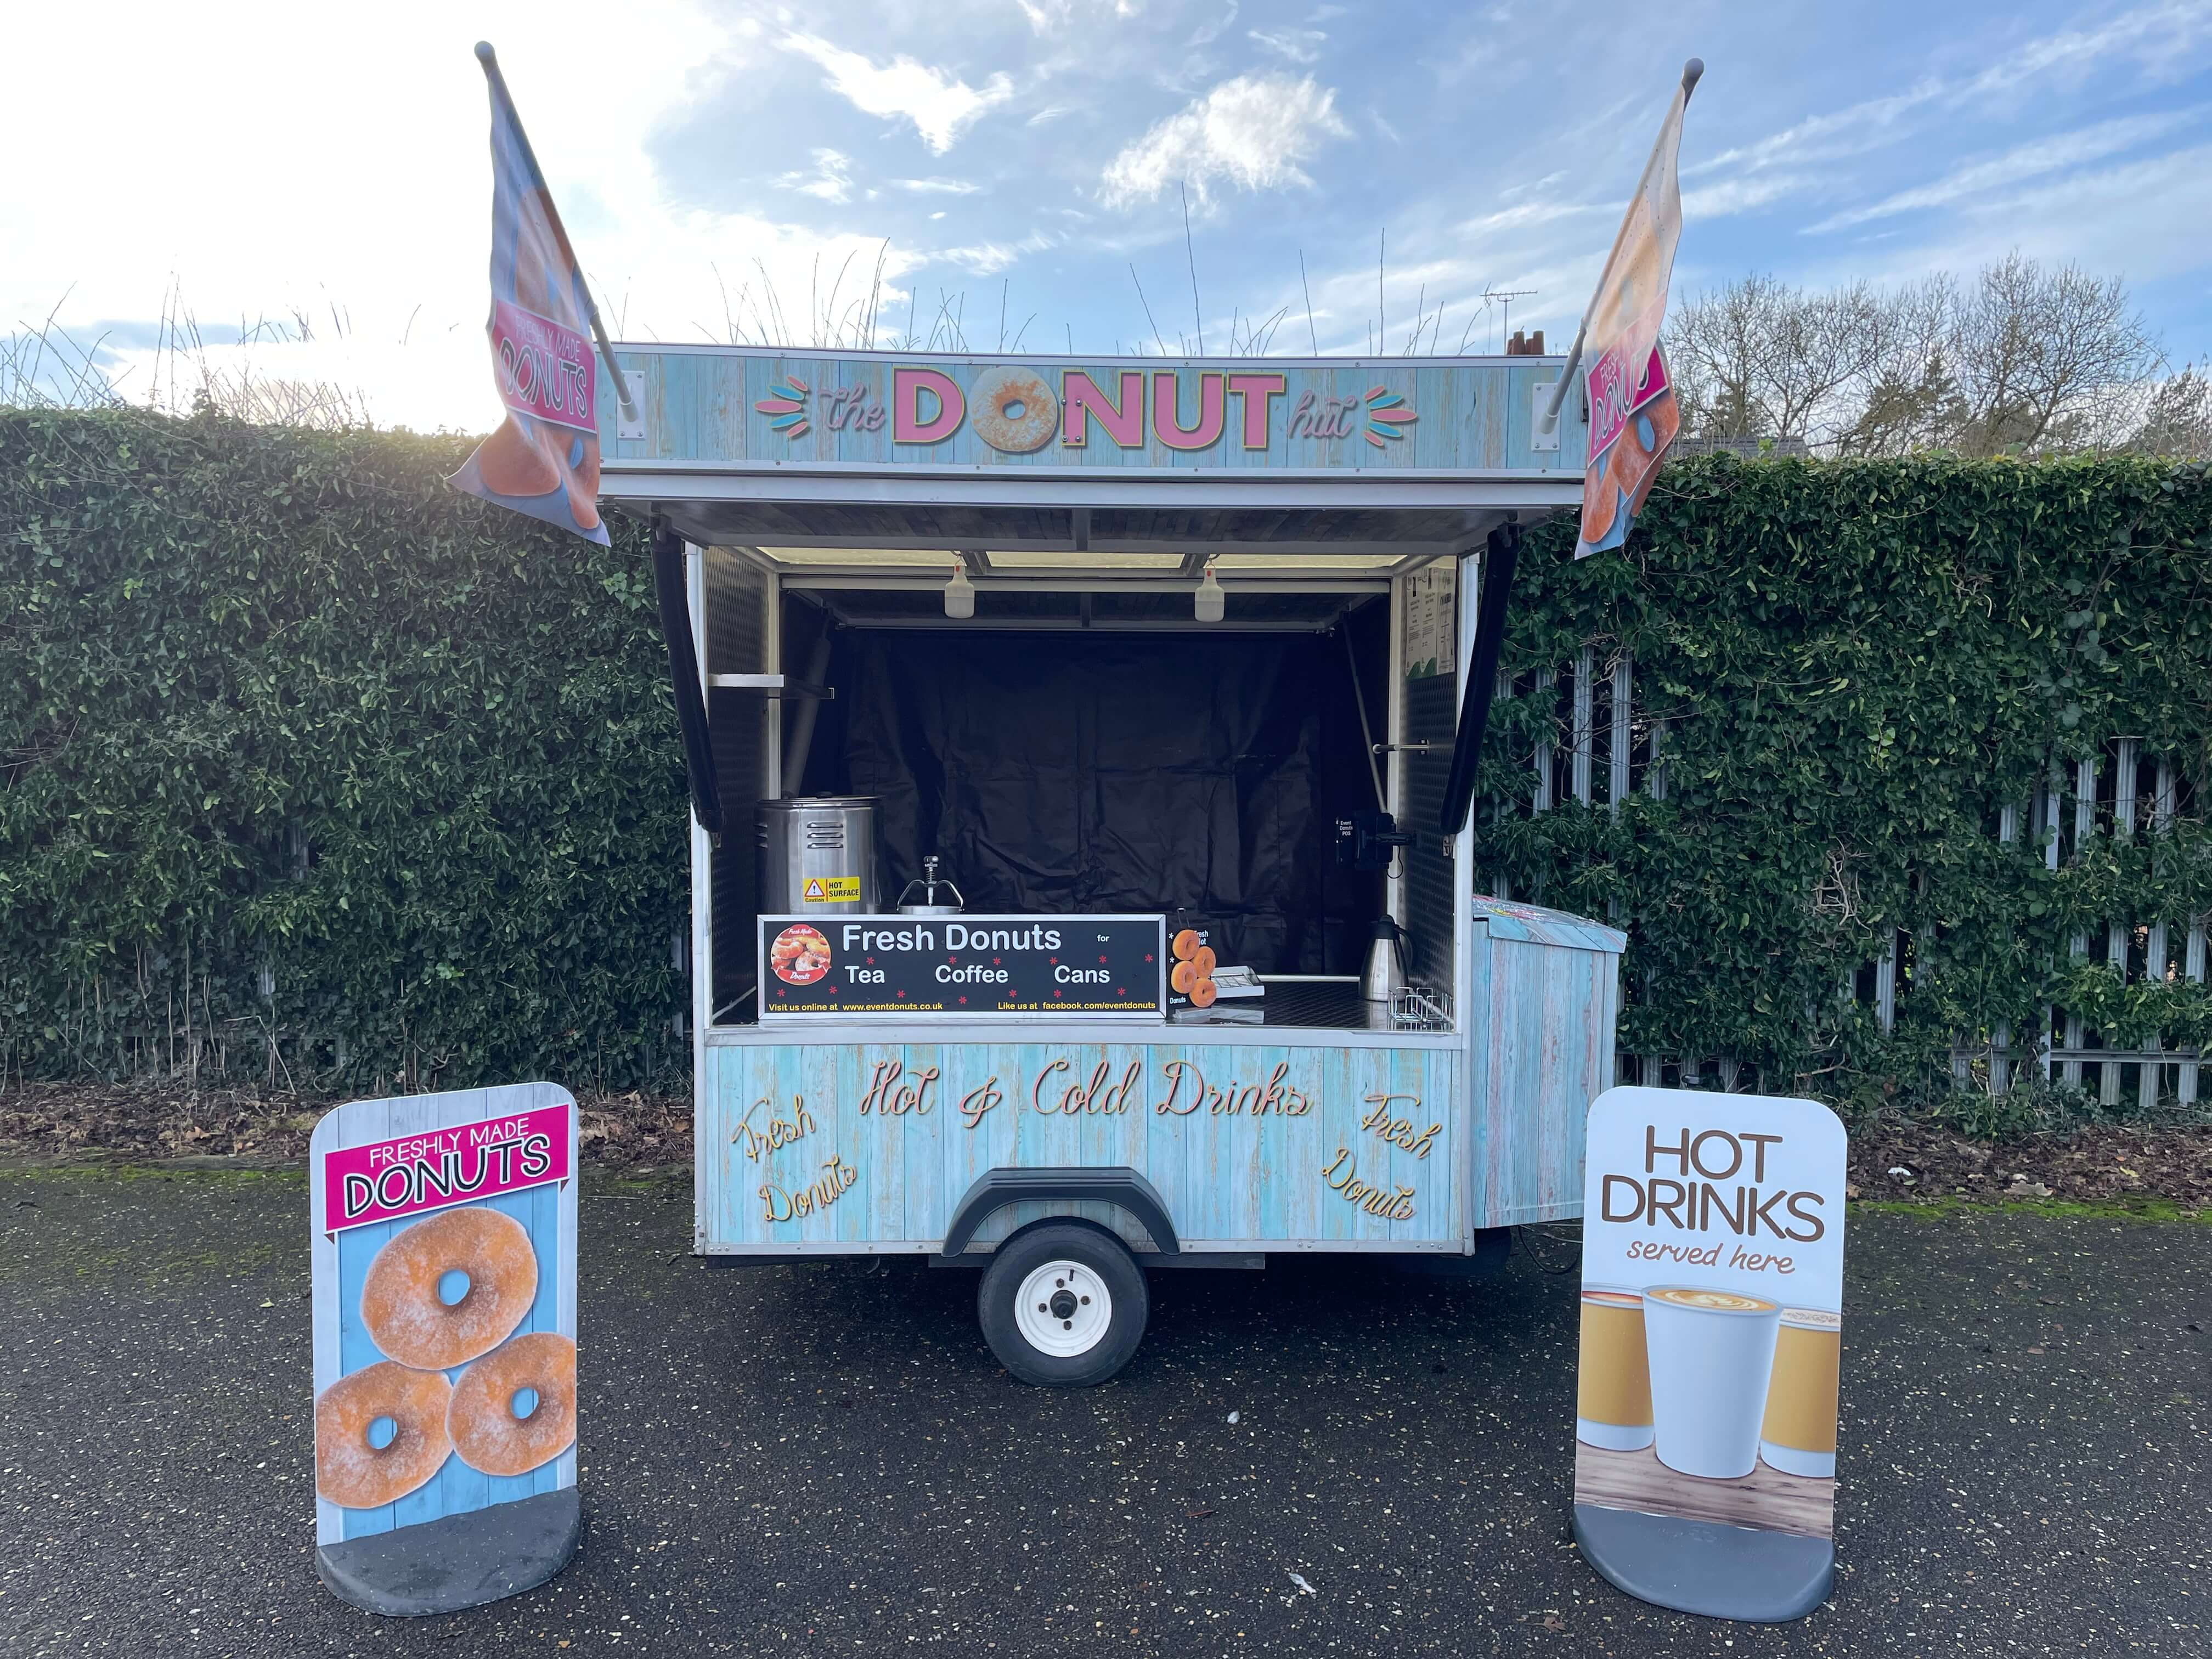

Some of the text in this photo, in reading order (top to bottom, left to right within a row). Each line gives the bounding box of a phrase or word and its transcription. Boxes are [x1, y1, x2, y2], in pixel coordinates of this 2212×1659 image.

[515, 315, 580, 362] FRESHLY MADE
[500, 337, 587, 418] DONUTS
[817, 382, 885, 430] the
[1288, 388, 1357, 437] hut
[829, 889, 859, 898] SURFACE
[843, 924, 1110, 951] Fresh Donuts for
[790, 972, 810, 980] Donuts
[844, 964, 1110, 984] Tea Coffee Cans
[843, 1002, 943, 1011] www.eventdonuts.co.uk
[998, 1002, 1015, 1010] Like
[1043, 1001, 1155, 1010] facebook.com/eventdonuts
[859, 1059, 940, 1115] Hot
[1031, 1056, 1141, 1115] Cold
[1154, 1059, 1314, 1115] Drinks
[369, 1117, 529, 1168] FRESHLY MADE
[731, 1094, 816, 1163] Fresh
[1361, 1093, 1442, 1159] Fresh
[343, 1133, 551, 1220] DONUTS
[1645, 1125, 1784, 1183] HOT
[757, 1153, 857, 1222] Donuts
[1320, 1147, 1417, 1221] Donuts
[1601, 1174, 1825, 1243] DRINKS
[1626, 1240, 1796, 1274] served here
